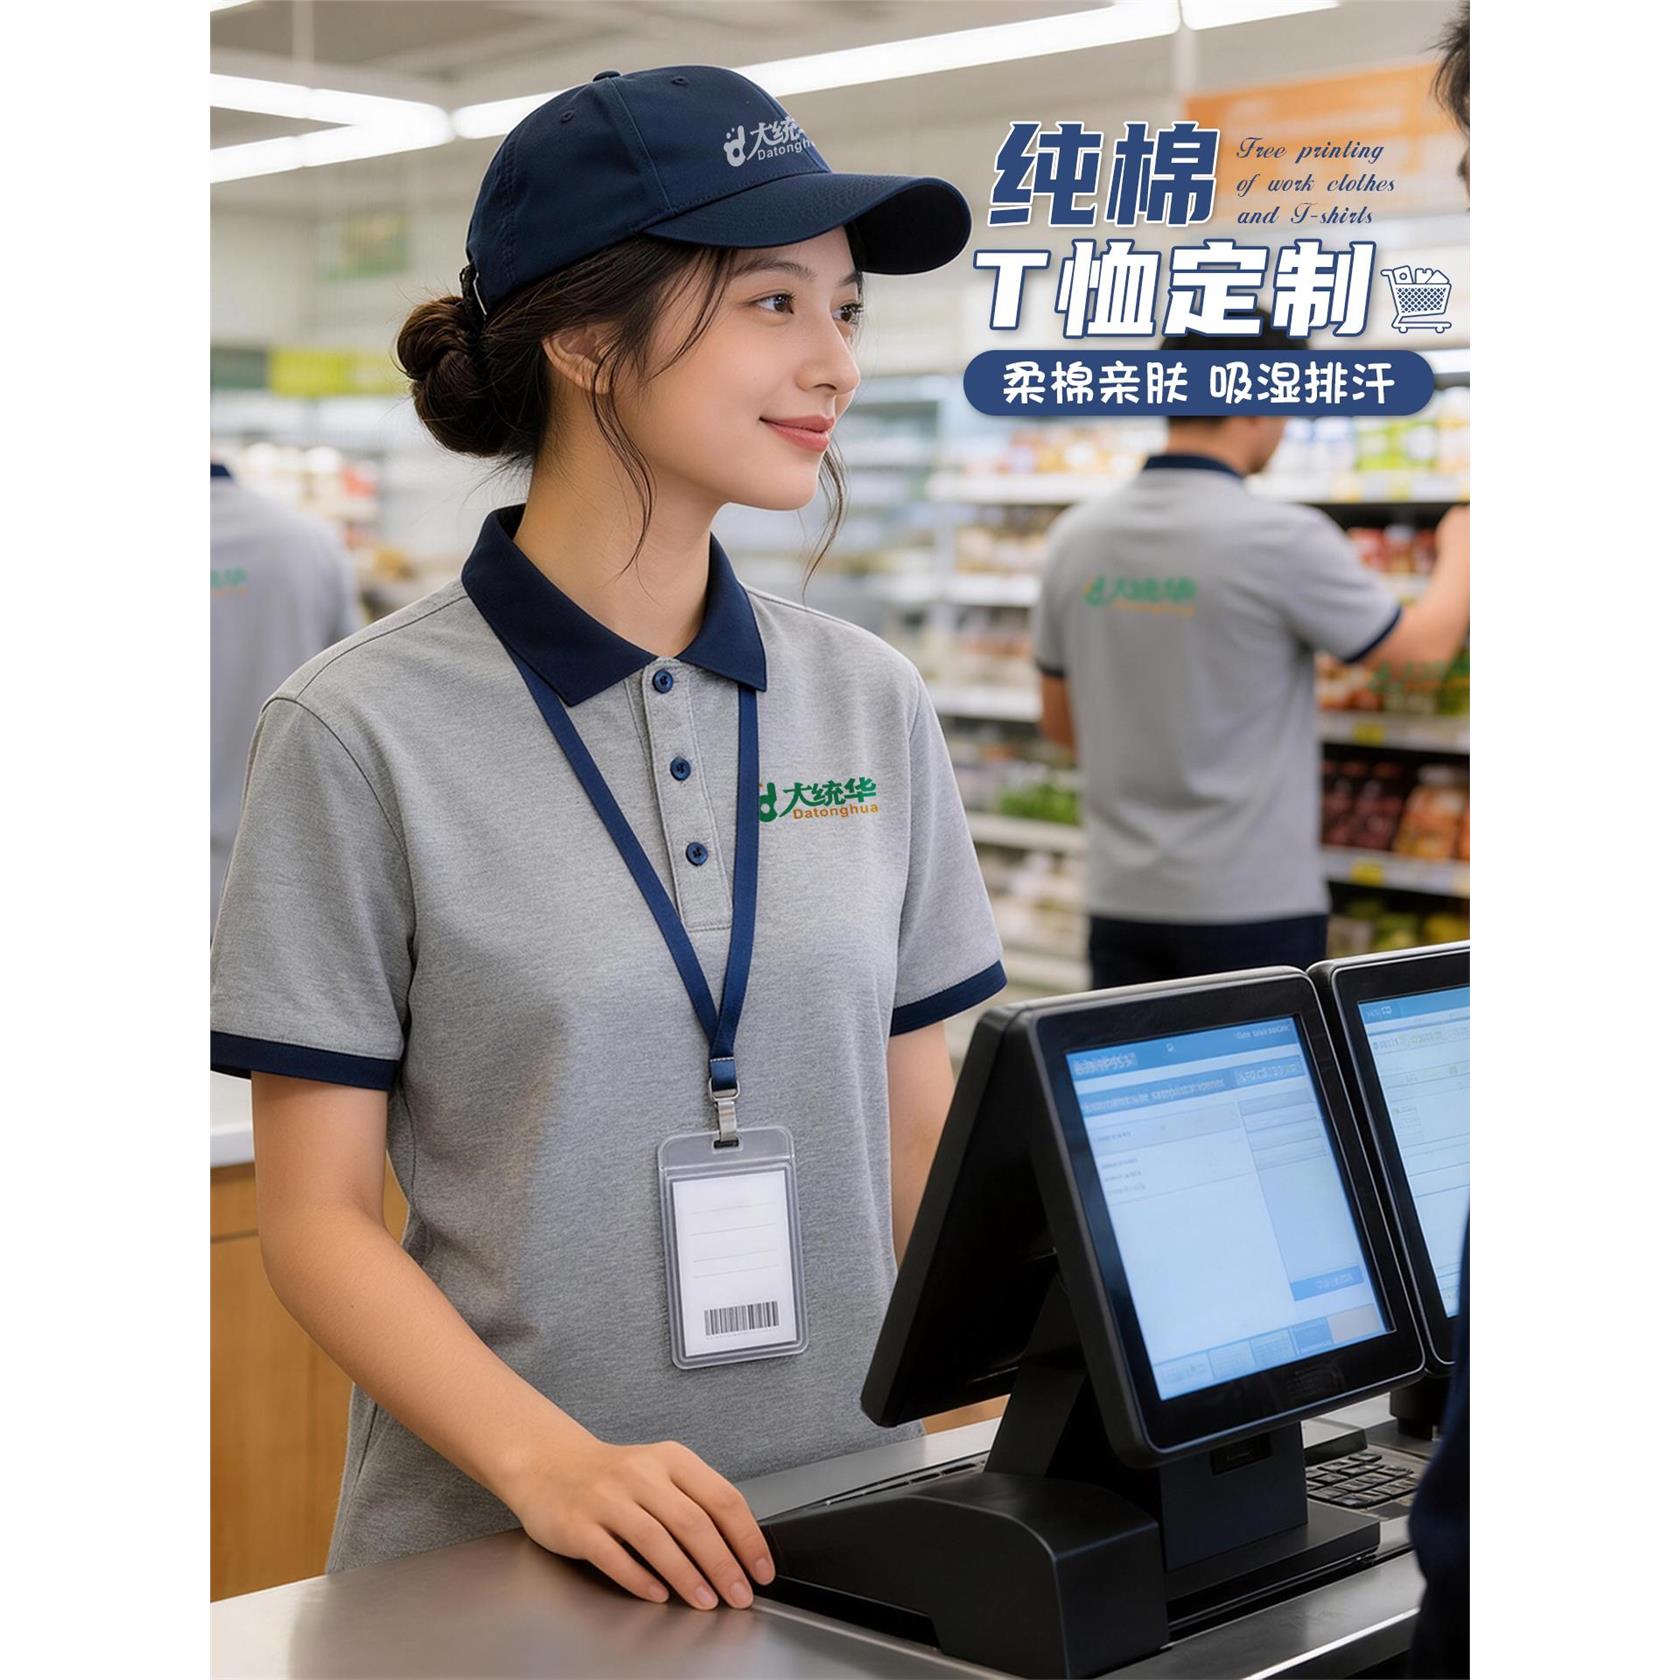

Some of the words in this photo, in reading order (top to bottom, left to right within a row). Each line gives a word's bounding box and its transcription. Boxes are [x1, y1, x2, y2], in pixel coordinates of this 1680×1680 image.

[747, 116, 806, 160] 大统
[779, 776, 876, 817] 大统华
[793, 803, 879, 820] Datonghua
